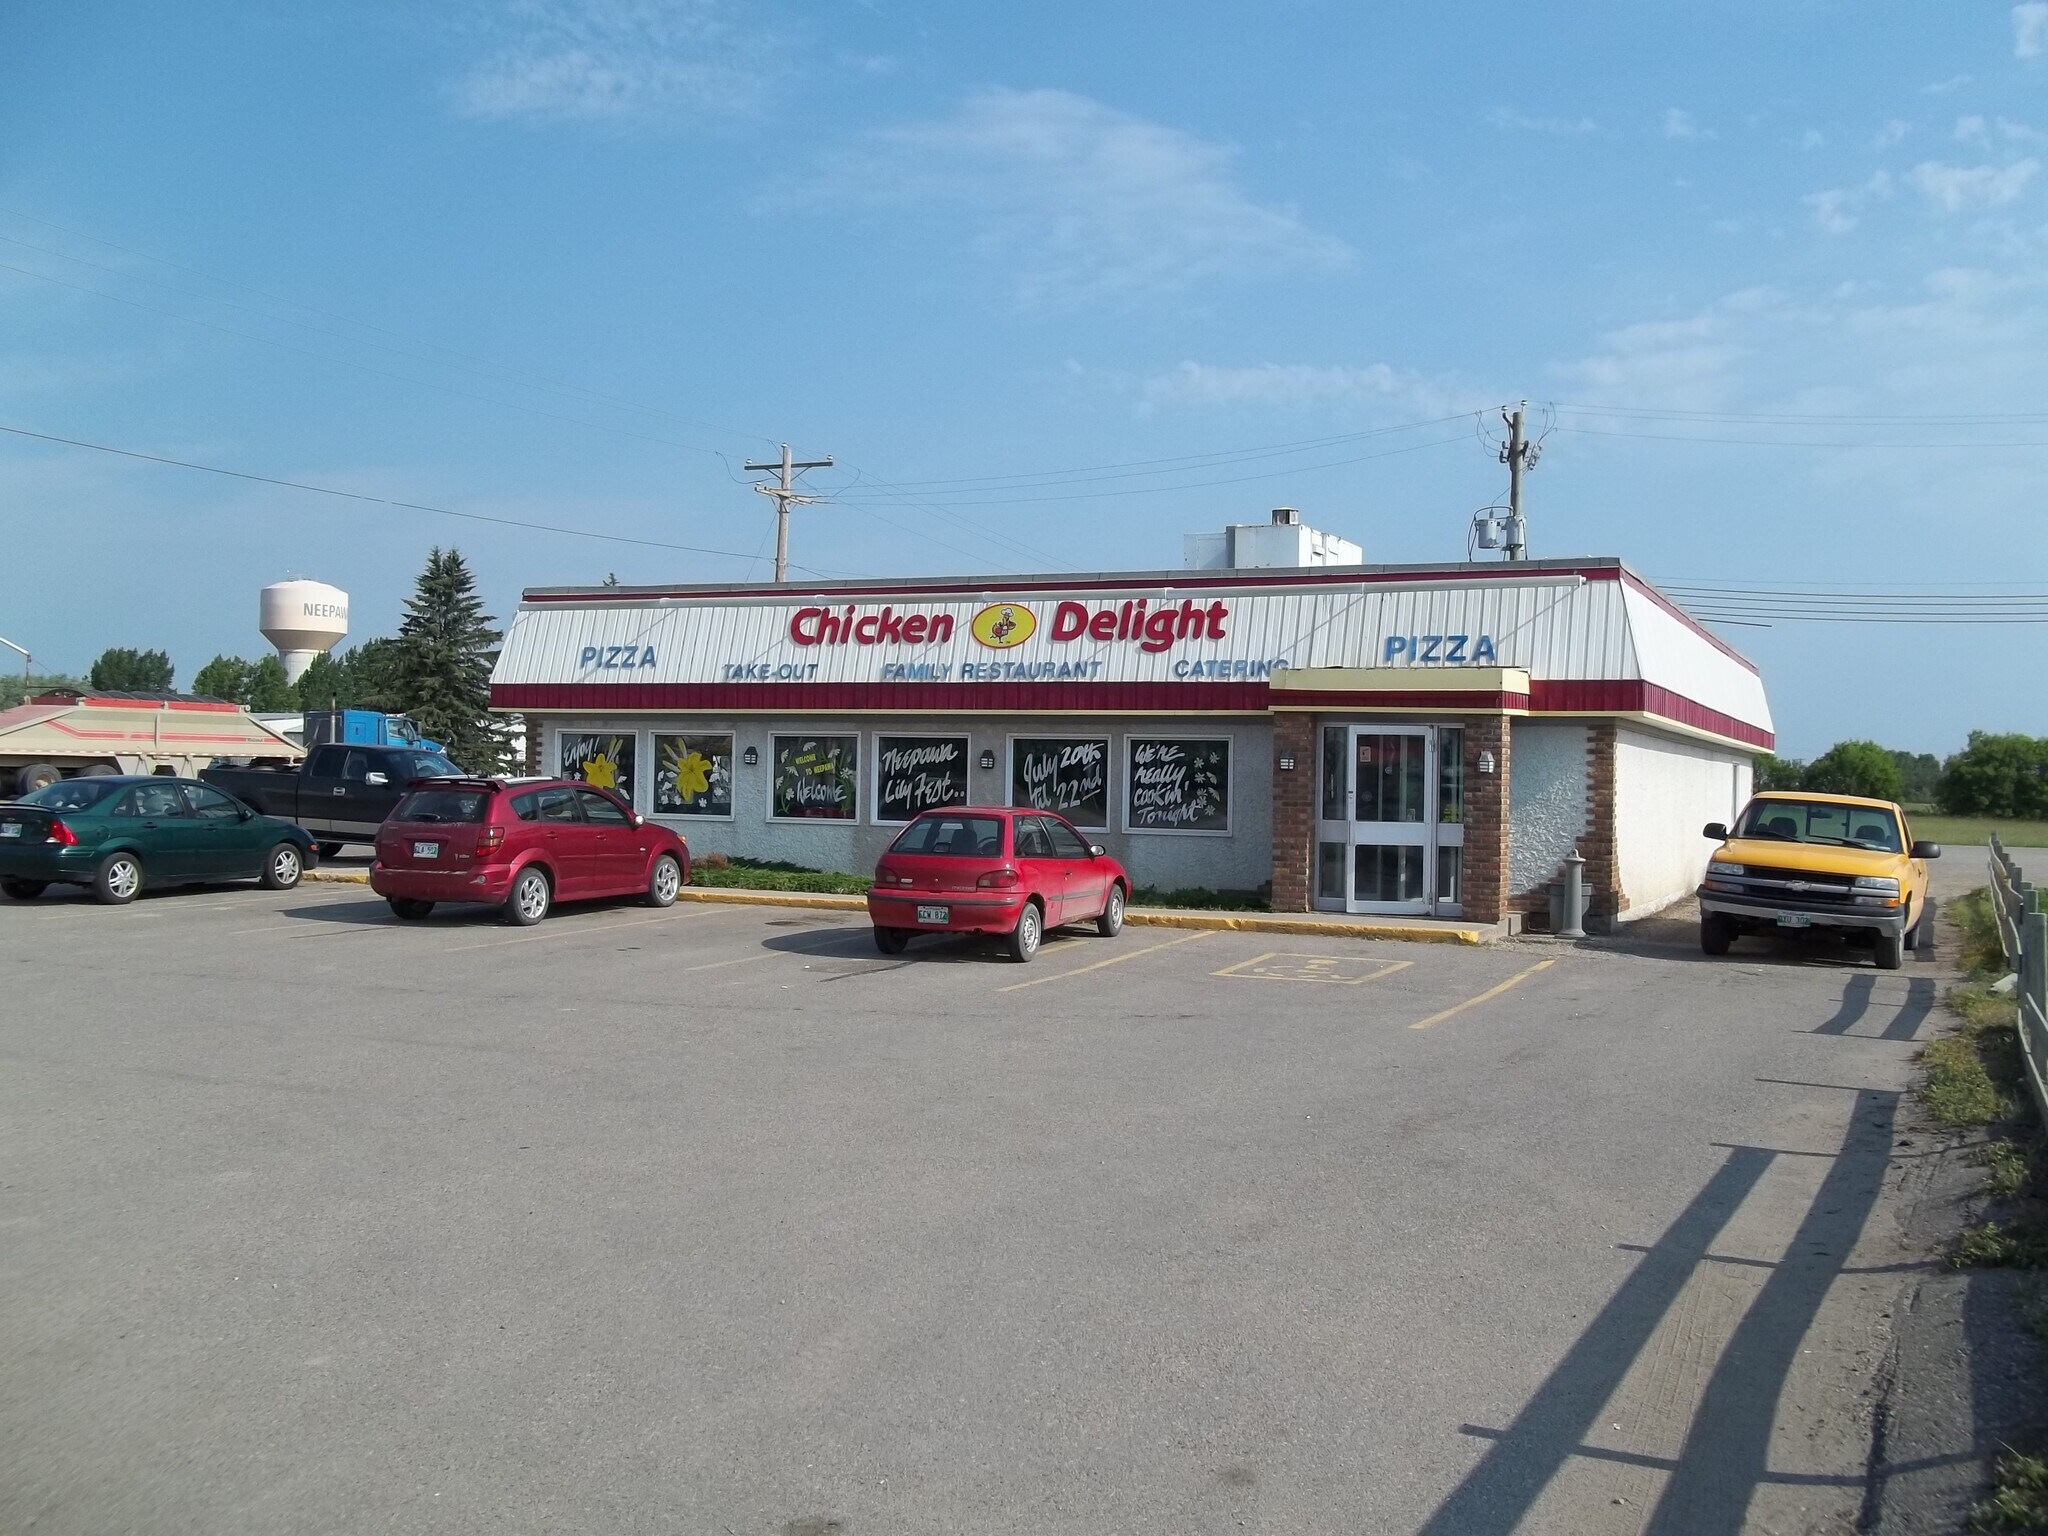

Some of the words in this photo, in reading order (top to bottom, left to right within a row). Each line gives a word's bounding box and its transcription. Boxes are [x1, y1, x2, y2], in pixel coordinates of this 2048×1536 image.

[790, 604, 954, 645] Chicken
[1051, 599, 1228, 652] Delight
[580, 646, 656, 669] PIZZA
[1384, 635, 1495, 662] PIZZA
[724, 663, 818, 680] TAKE-OUT
[884, 663, 951, 680] FAMILY
[961, 661, 1102, 680] RESTAURANT
[563, 736, 600, 769] Enjoy!
[1023, 753, 1058, 804] July
[1060, 743, 1105, 772] 20th
[1056, 764, 1102, 811] 22nd
[885, 779, 913, 810] Lily
[1137, 800, 1201, 827] Tonight
